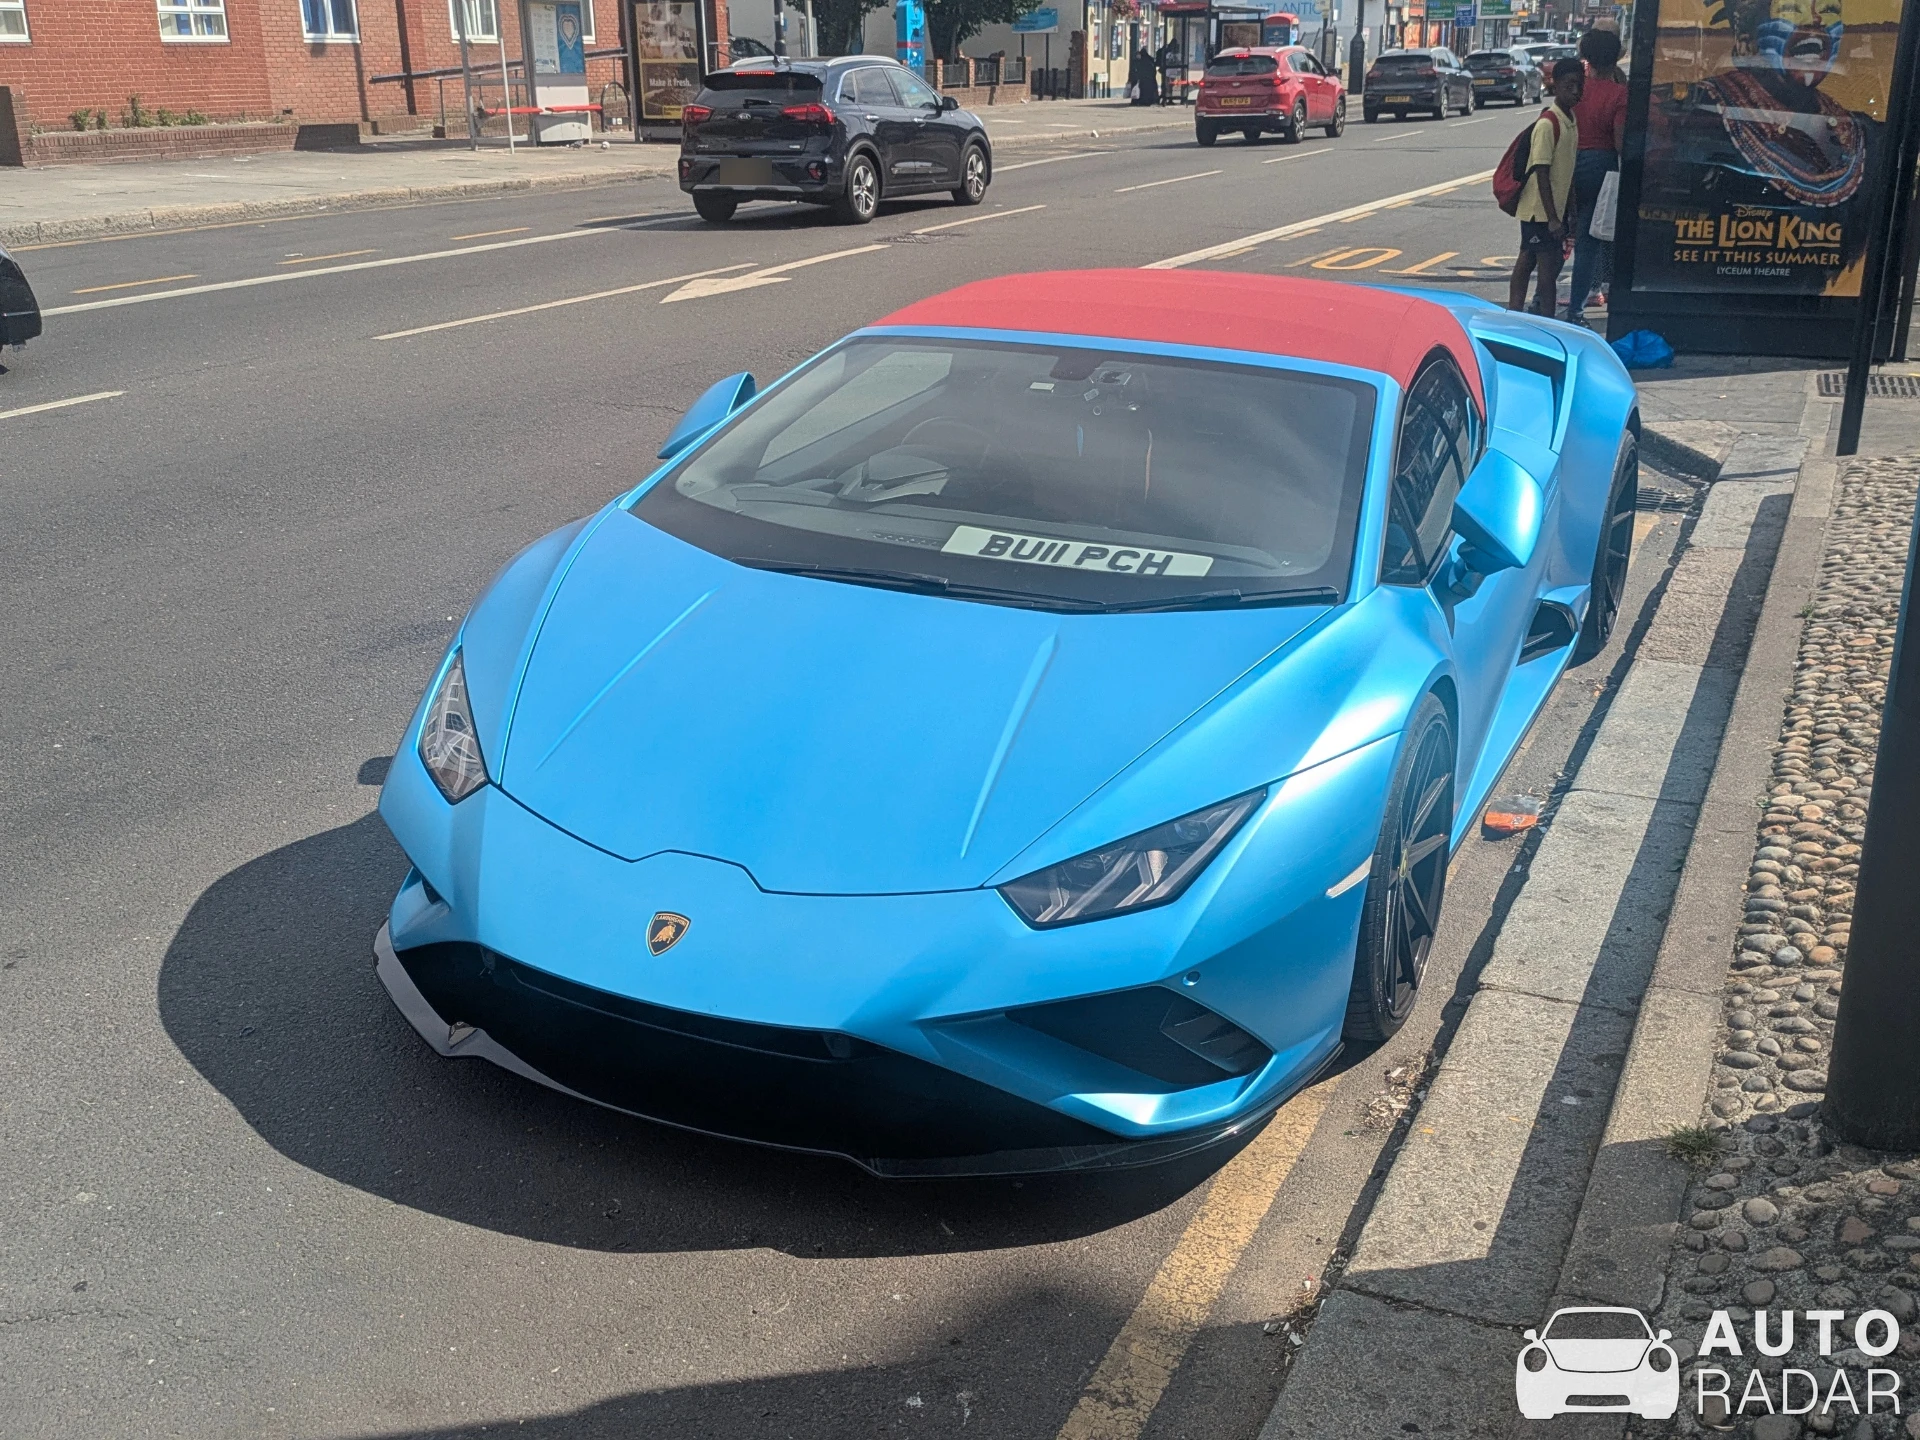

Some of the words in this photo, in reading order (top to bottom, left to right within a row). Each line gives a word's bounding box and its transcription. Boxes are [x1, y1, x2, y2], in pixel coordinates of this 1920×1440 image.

[649, 78, 666, 87] Make
[1736, 207, 1773, 220] Disney
[1675, 220, 1714, 239] THE
[1718, 214, 1774, 248] LION
[1777, 215, 1842, 249] KING
[1673, 250, 1699, 262] SEE
[1704, 250, 1720, 263] IT
[1723, 251, 1762, 263] THIS
[1766, 252, 1840, 265] SUMMER
[1717, 266, 1750, 275] LYCEUM
[1754, 267, 1791, 277] THEATRE
[1075, 546, 1174, 575] PCH
